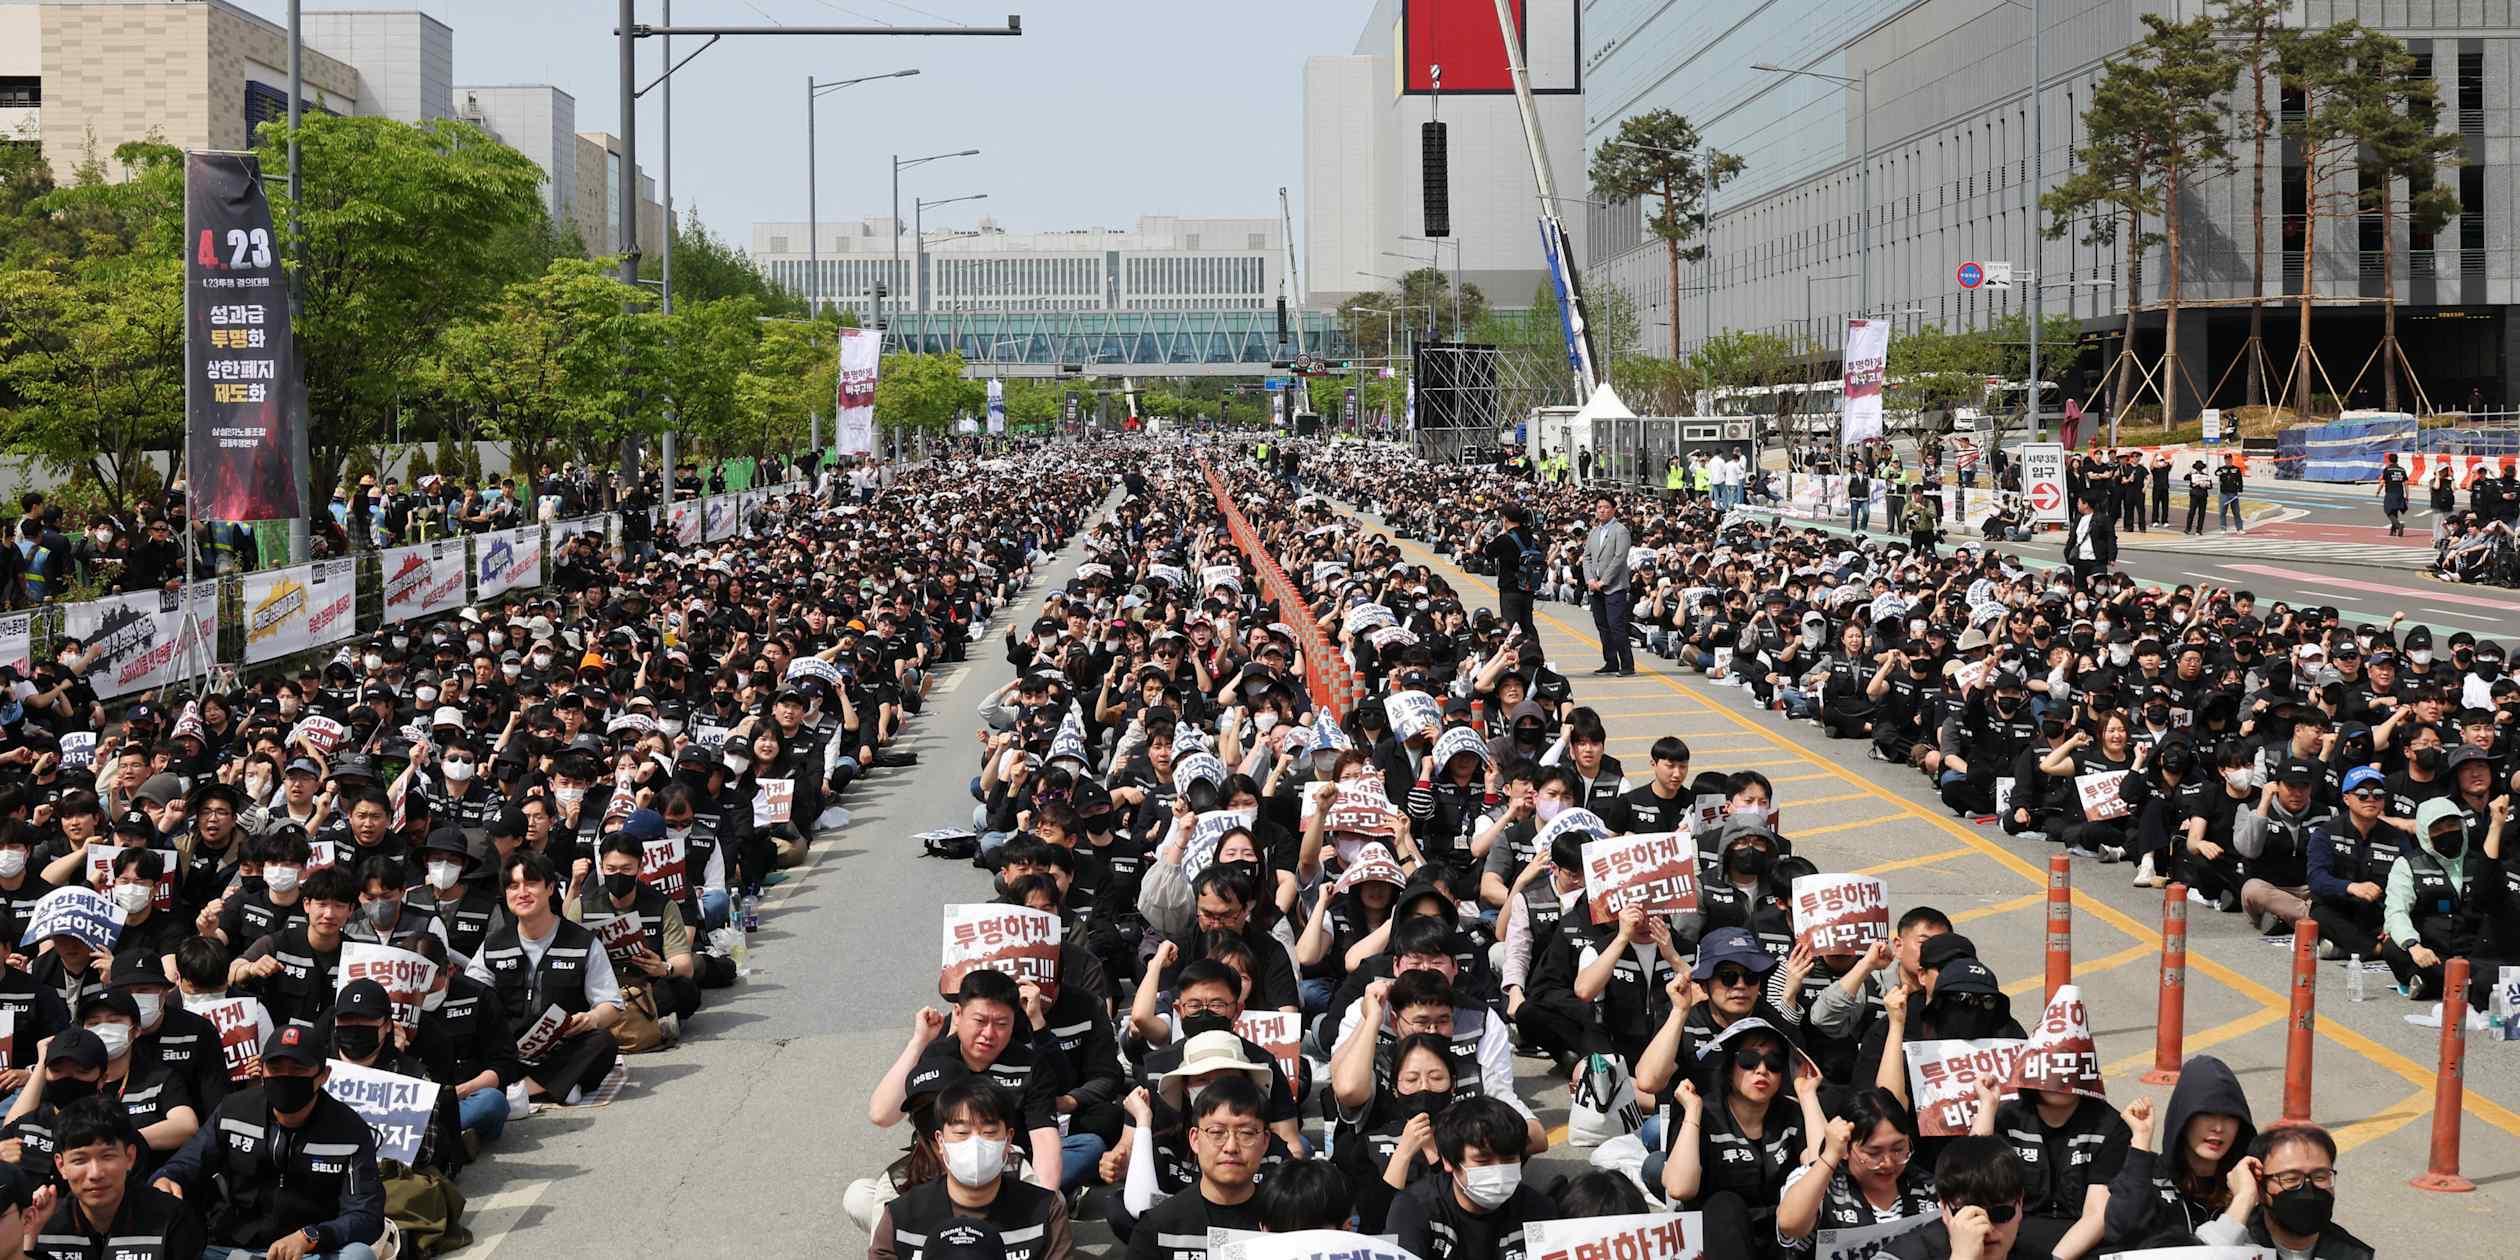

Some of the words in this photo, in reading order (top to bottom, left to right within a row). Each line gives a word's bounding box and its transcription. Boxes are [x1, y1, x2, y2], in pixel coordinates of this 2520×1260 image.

[198, 228, 272, 269] 4.23
[210, 305, 265, 325] 성과급
[211, 329, 265, 349] 투명화
[207, 360, 275, 380] 상한폐지
[214, 383, 266, 403] 제도화
[2032, 467, 2056, 478] 입구
[1592, 836, 1680, 881] 투명하게
[1800, 881, 1881, 917] 투명하게
[244, 912, 268, 927] 투쟁
[457, 923, 480, 932] SELU
[953, 914, 1050, 950] 투명하게
[1812, 920, 1888, 950] 바꾸고!!!
[285, 964, 307, 980] 투쟁
[496, 959, 517, 970] 투쟁
[552, 961, 575, 970] SELU
[965, 957, 1055, 984] 꾸고!!!
[3, 1004, 28, 1013] SELU
[446, 1008, 471, 1018] SELU
[162, 1051, 190, 1060] SELU
[913, 1069, 939, 1086] NSEU
[128, 1103, 157, 1115] SELU
[24, 1135, 54, 1152] 투쟁
[229, 1133, 255, 1152] 투쟁
[1723, 1148, 1755, 1163] 투쟁
[311, 1162, 342, 1173] SELU
